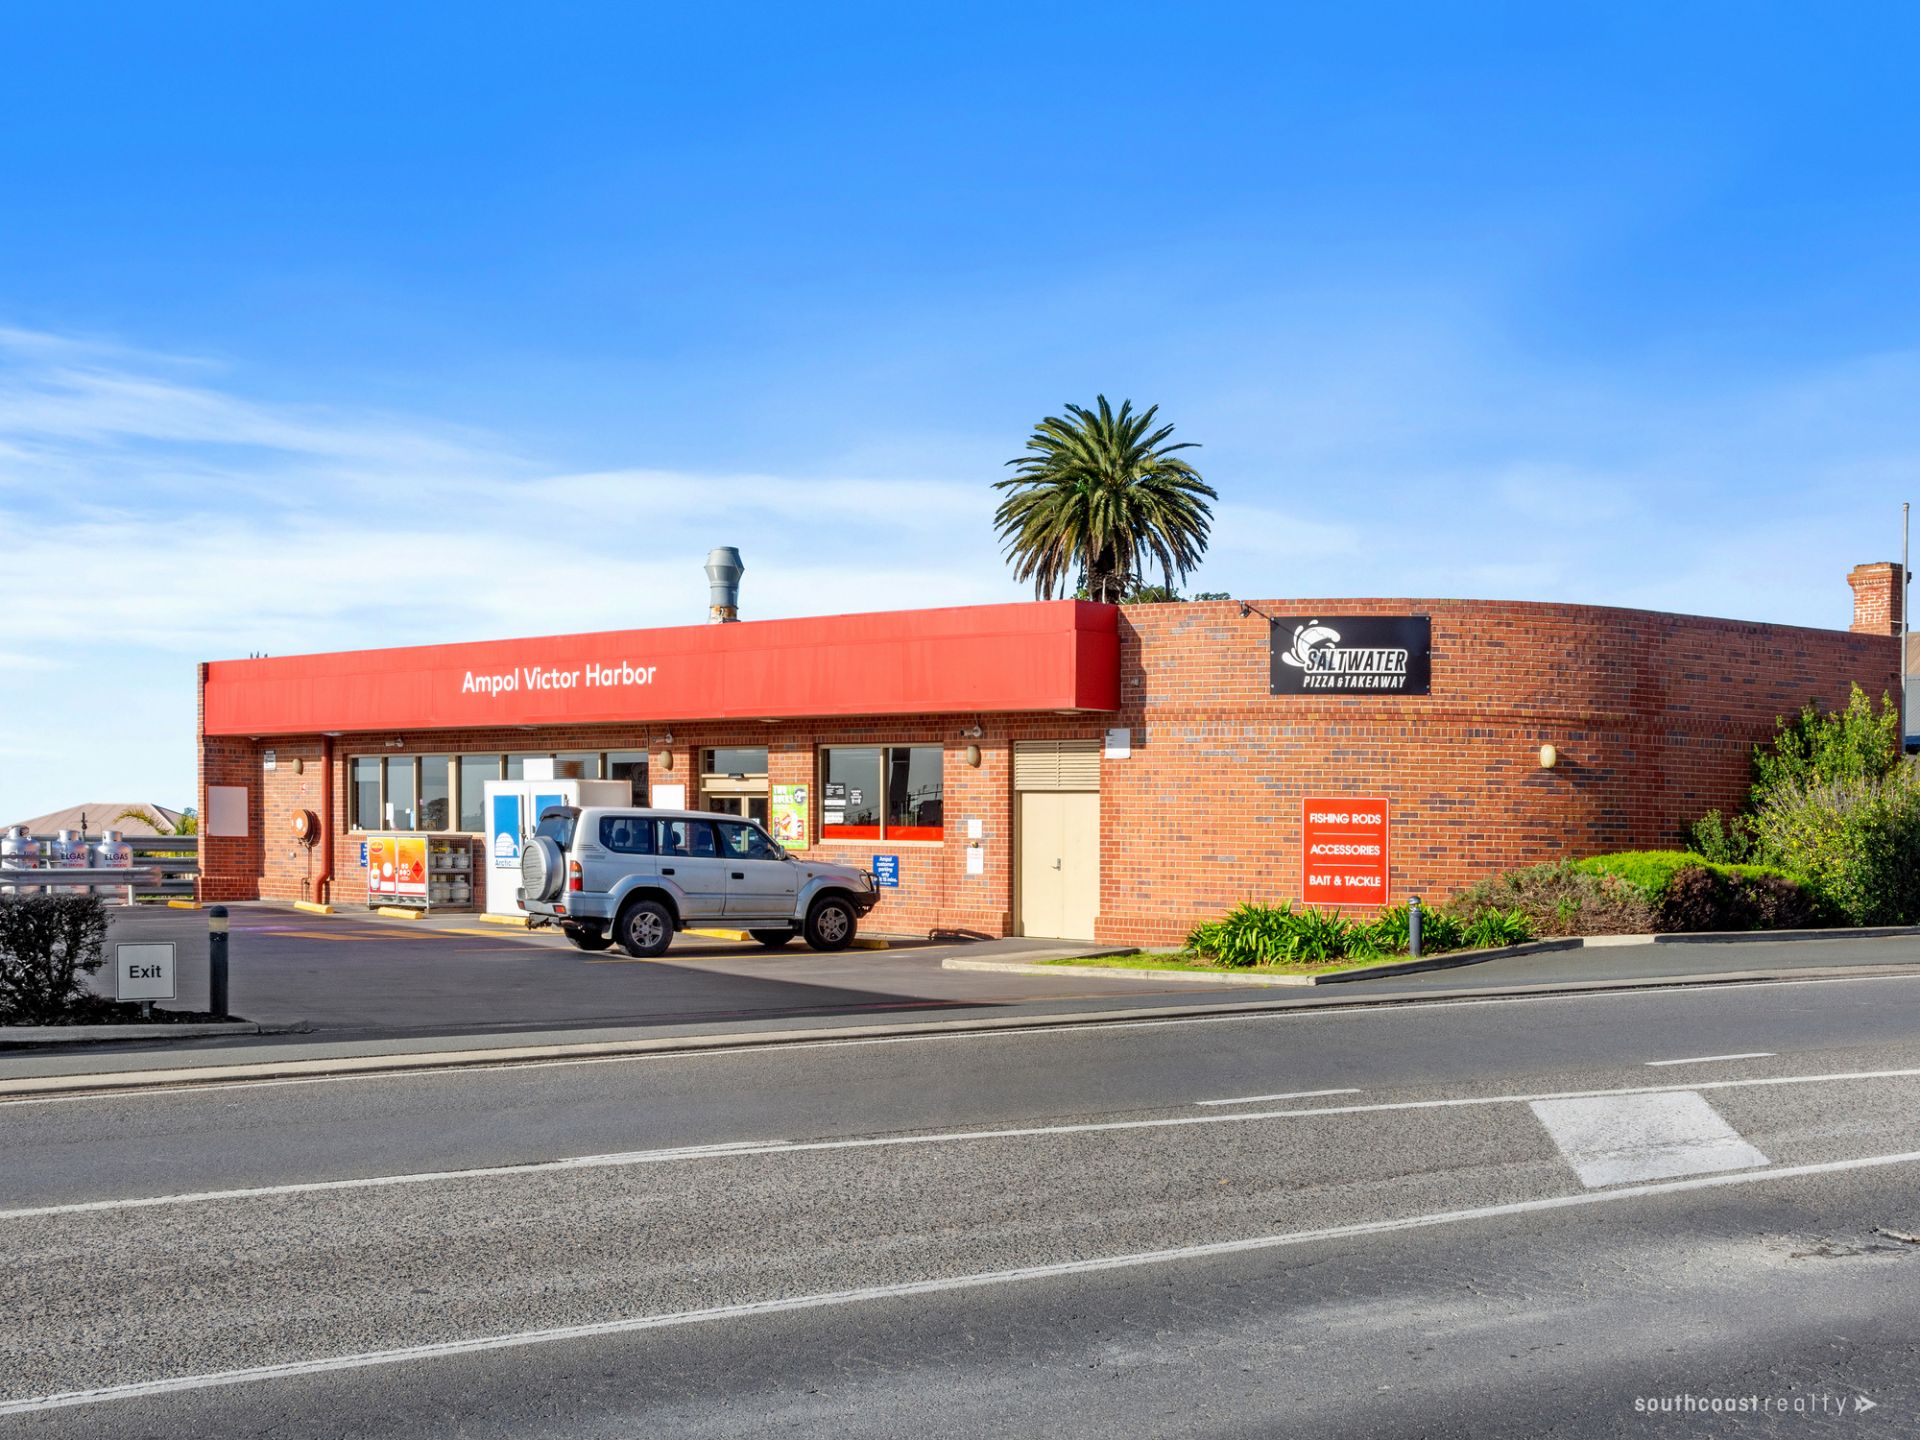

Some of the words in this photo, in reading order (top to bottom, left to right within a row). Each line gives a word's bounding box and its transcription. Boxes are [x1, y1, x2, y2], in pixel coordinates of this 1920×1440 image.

[1306, 650, 1407, 672] SALTWATER
[462, 668, 519, 697] Ampol
[523, 667, 580, 690] Victor
[586, 661, 656, 687] Harbor
[1303, 676, 1335, 688] PIZZA
[1337, 677, 1343, 688] &
[1344, 676, 1406, 688] TAKEAWAY
[1309, 812, 1350, 824] FISHING
[1352, 813, 1382, 825] RODS
[61, 852, 86, 860] ELGAS
[1310, 844, 1381, 856] ACCESSORIES
[105, 853, 129, 861] ELGAS
[1309, 875, 1332, 886] BAIT
[1334, 875, 1342, 886] &
[1344, 876, 1381, 887] TACKLE
[129, 965, 162, 978] Exit
